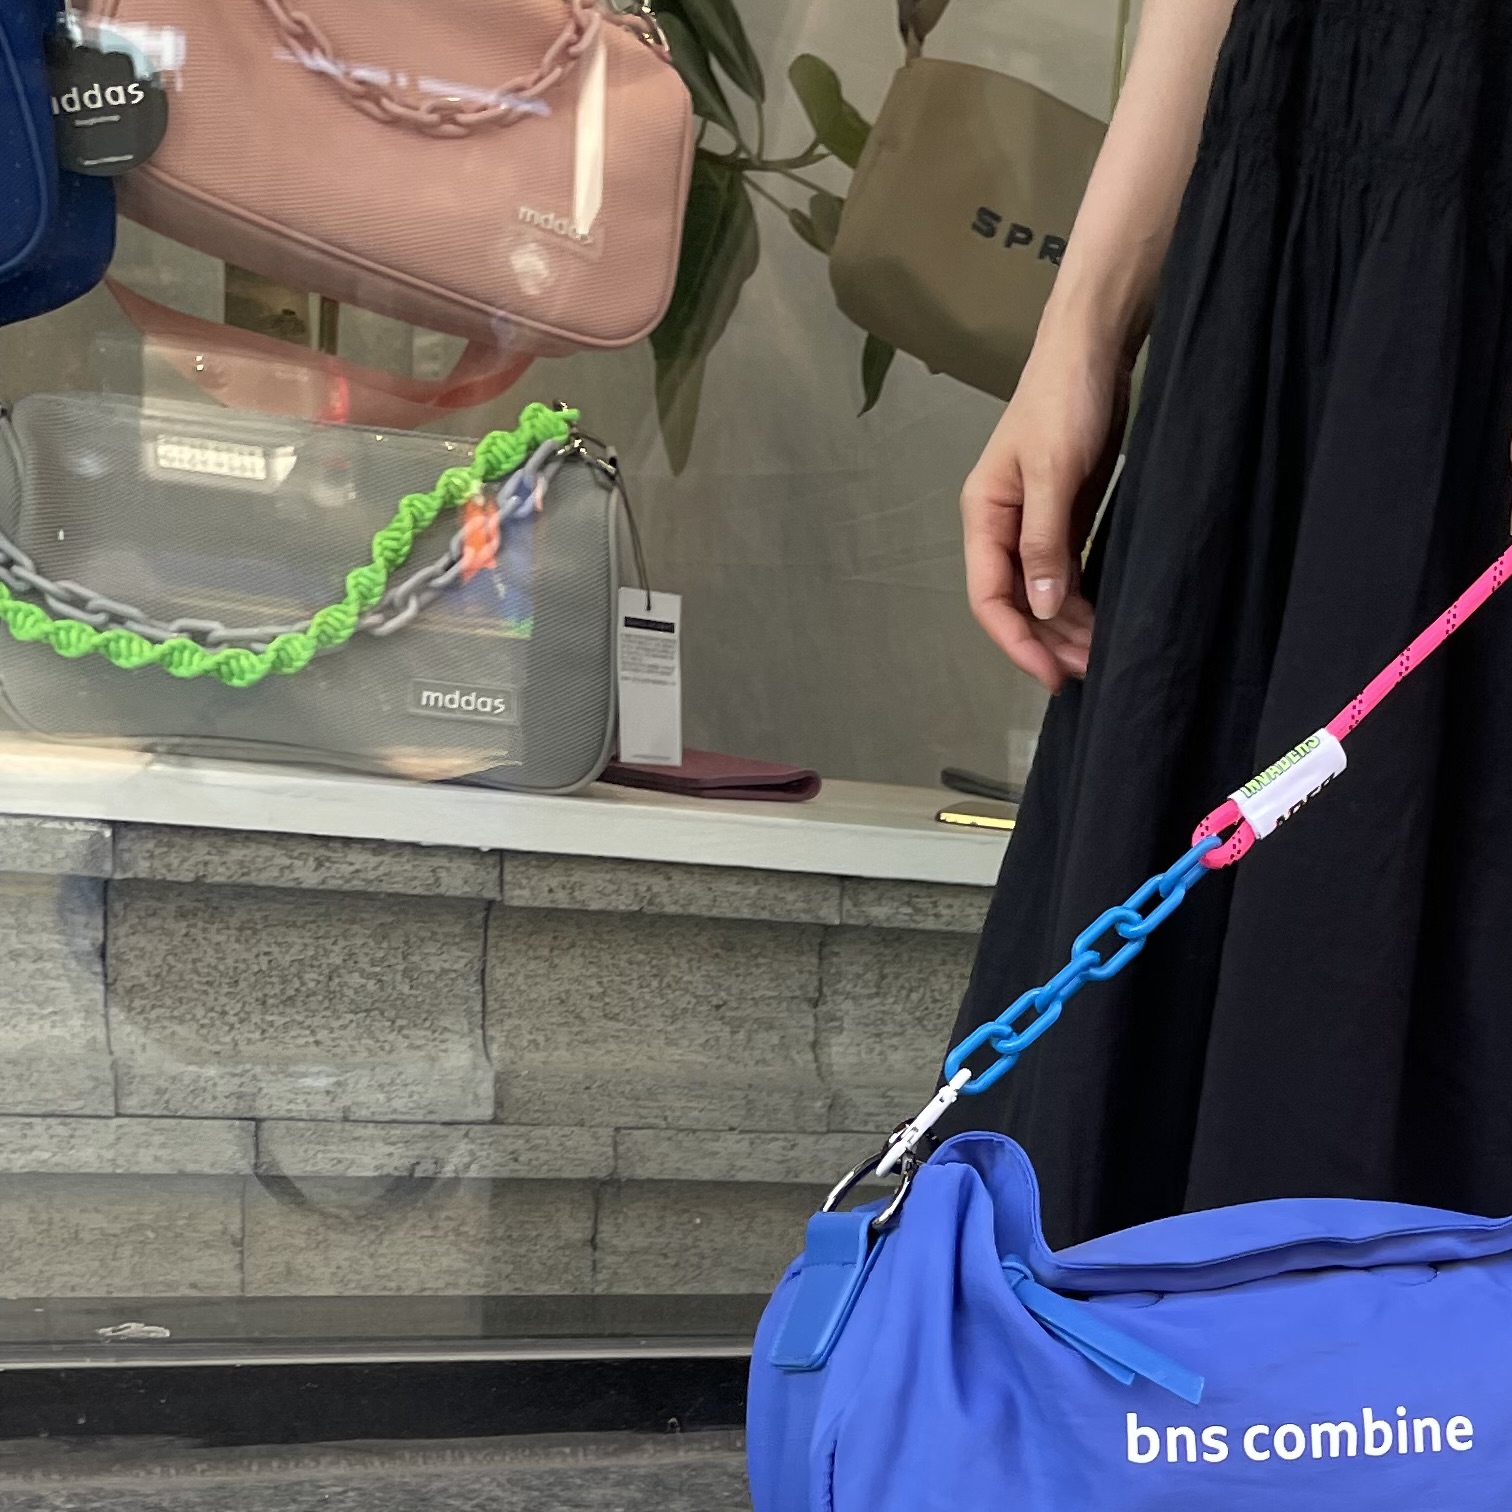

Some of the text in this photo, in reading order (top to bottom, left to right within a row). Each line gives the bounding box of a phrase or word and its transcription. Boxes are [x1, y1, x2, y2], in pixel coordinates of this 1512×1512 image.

[421, 690, 506, 715] mddas
[1126, 1405, 1474, 1464] bns combine
